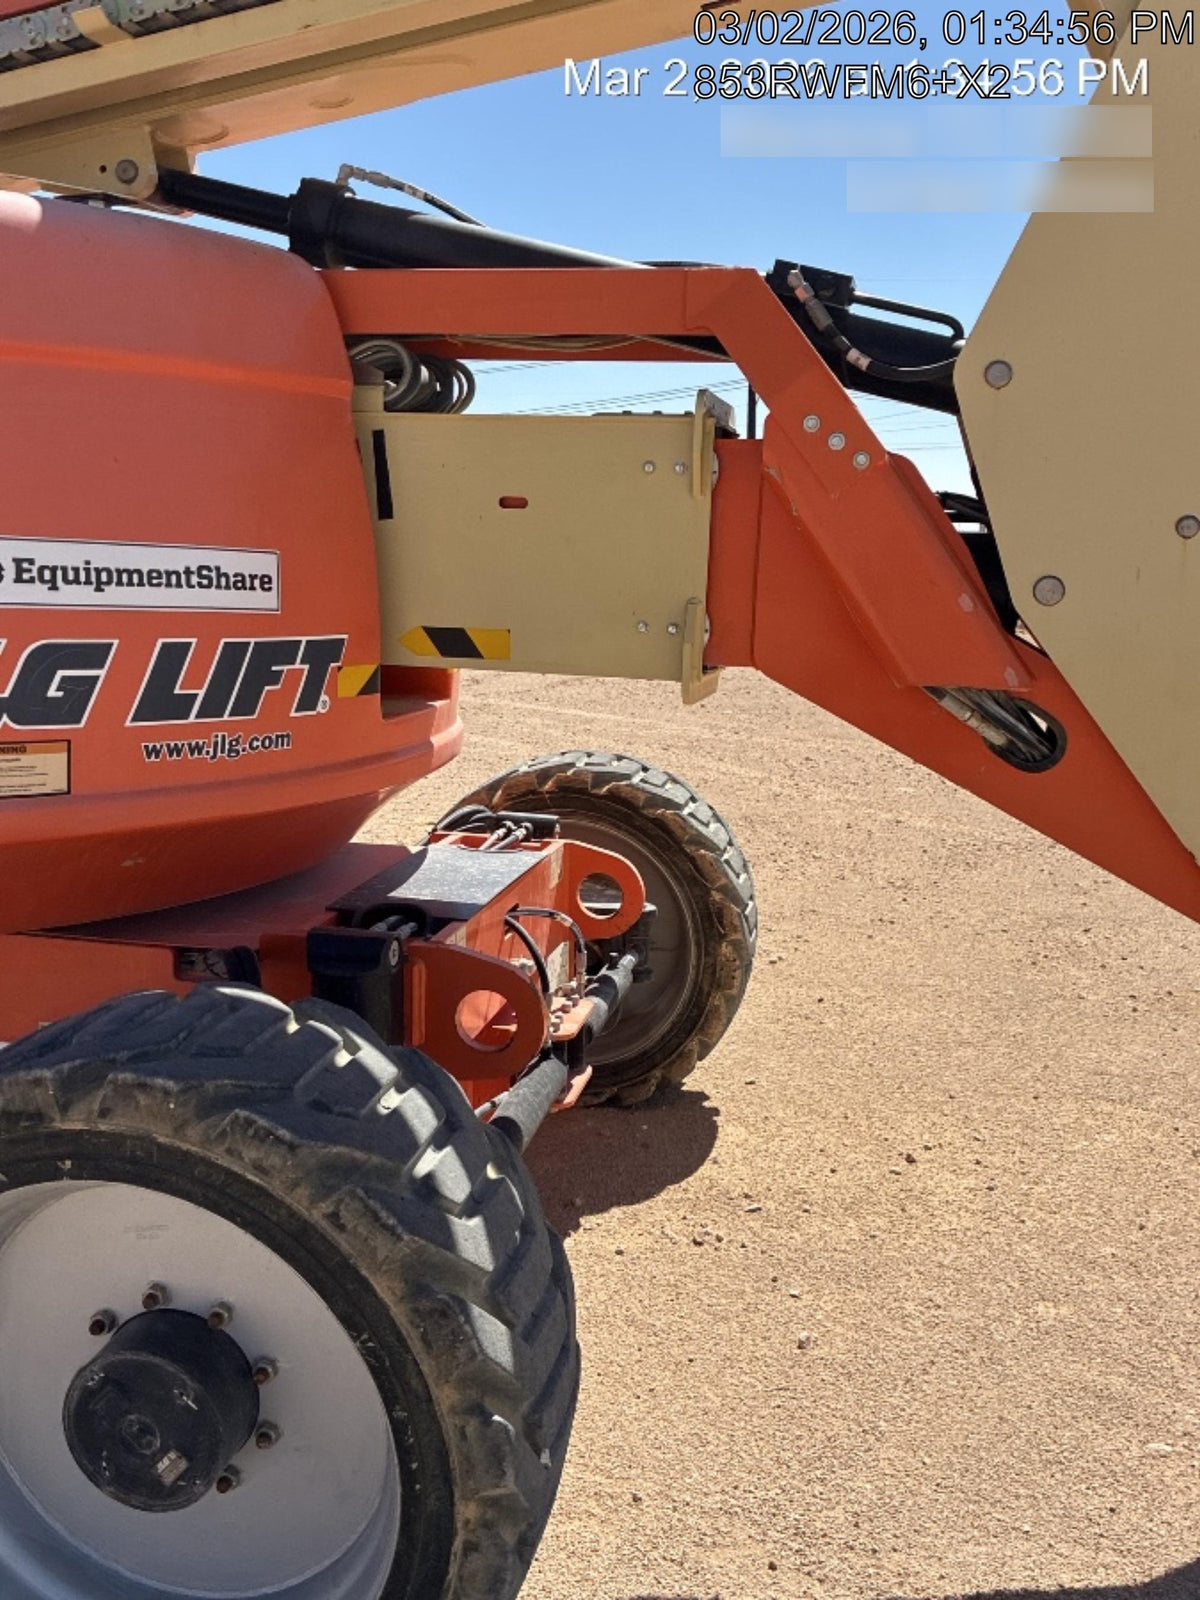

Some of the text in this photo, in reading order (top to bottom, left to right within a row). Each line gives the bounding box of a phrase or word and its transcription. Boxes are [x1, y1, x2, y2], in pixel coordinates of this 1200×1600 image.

[12, 558, 273, 592] EquipmentShare
[125, 634, 348, 728] LIFT
[142, 731, 292, 761] www.jlg.com
